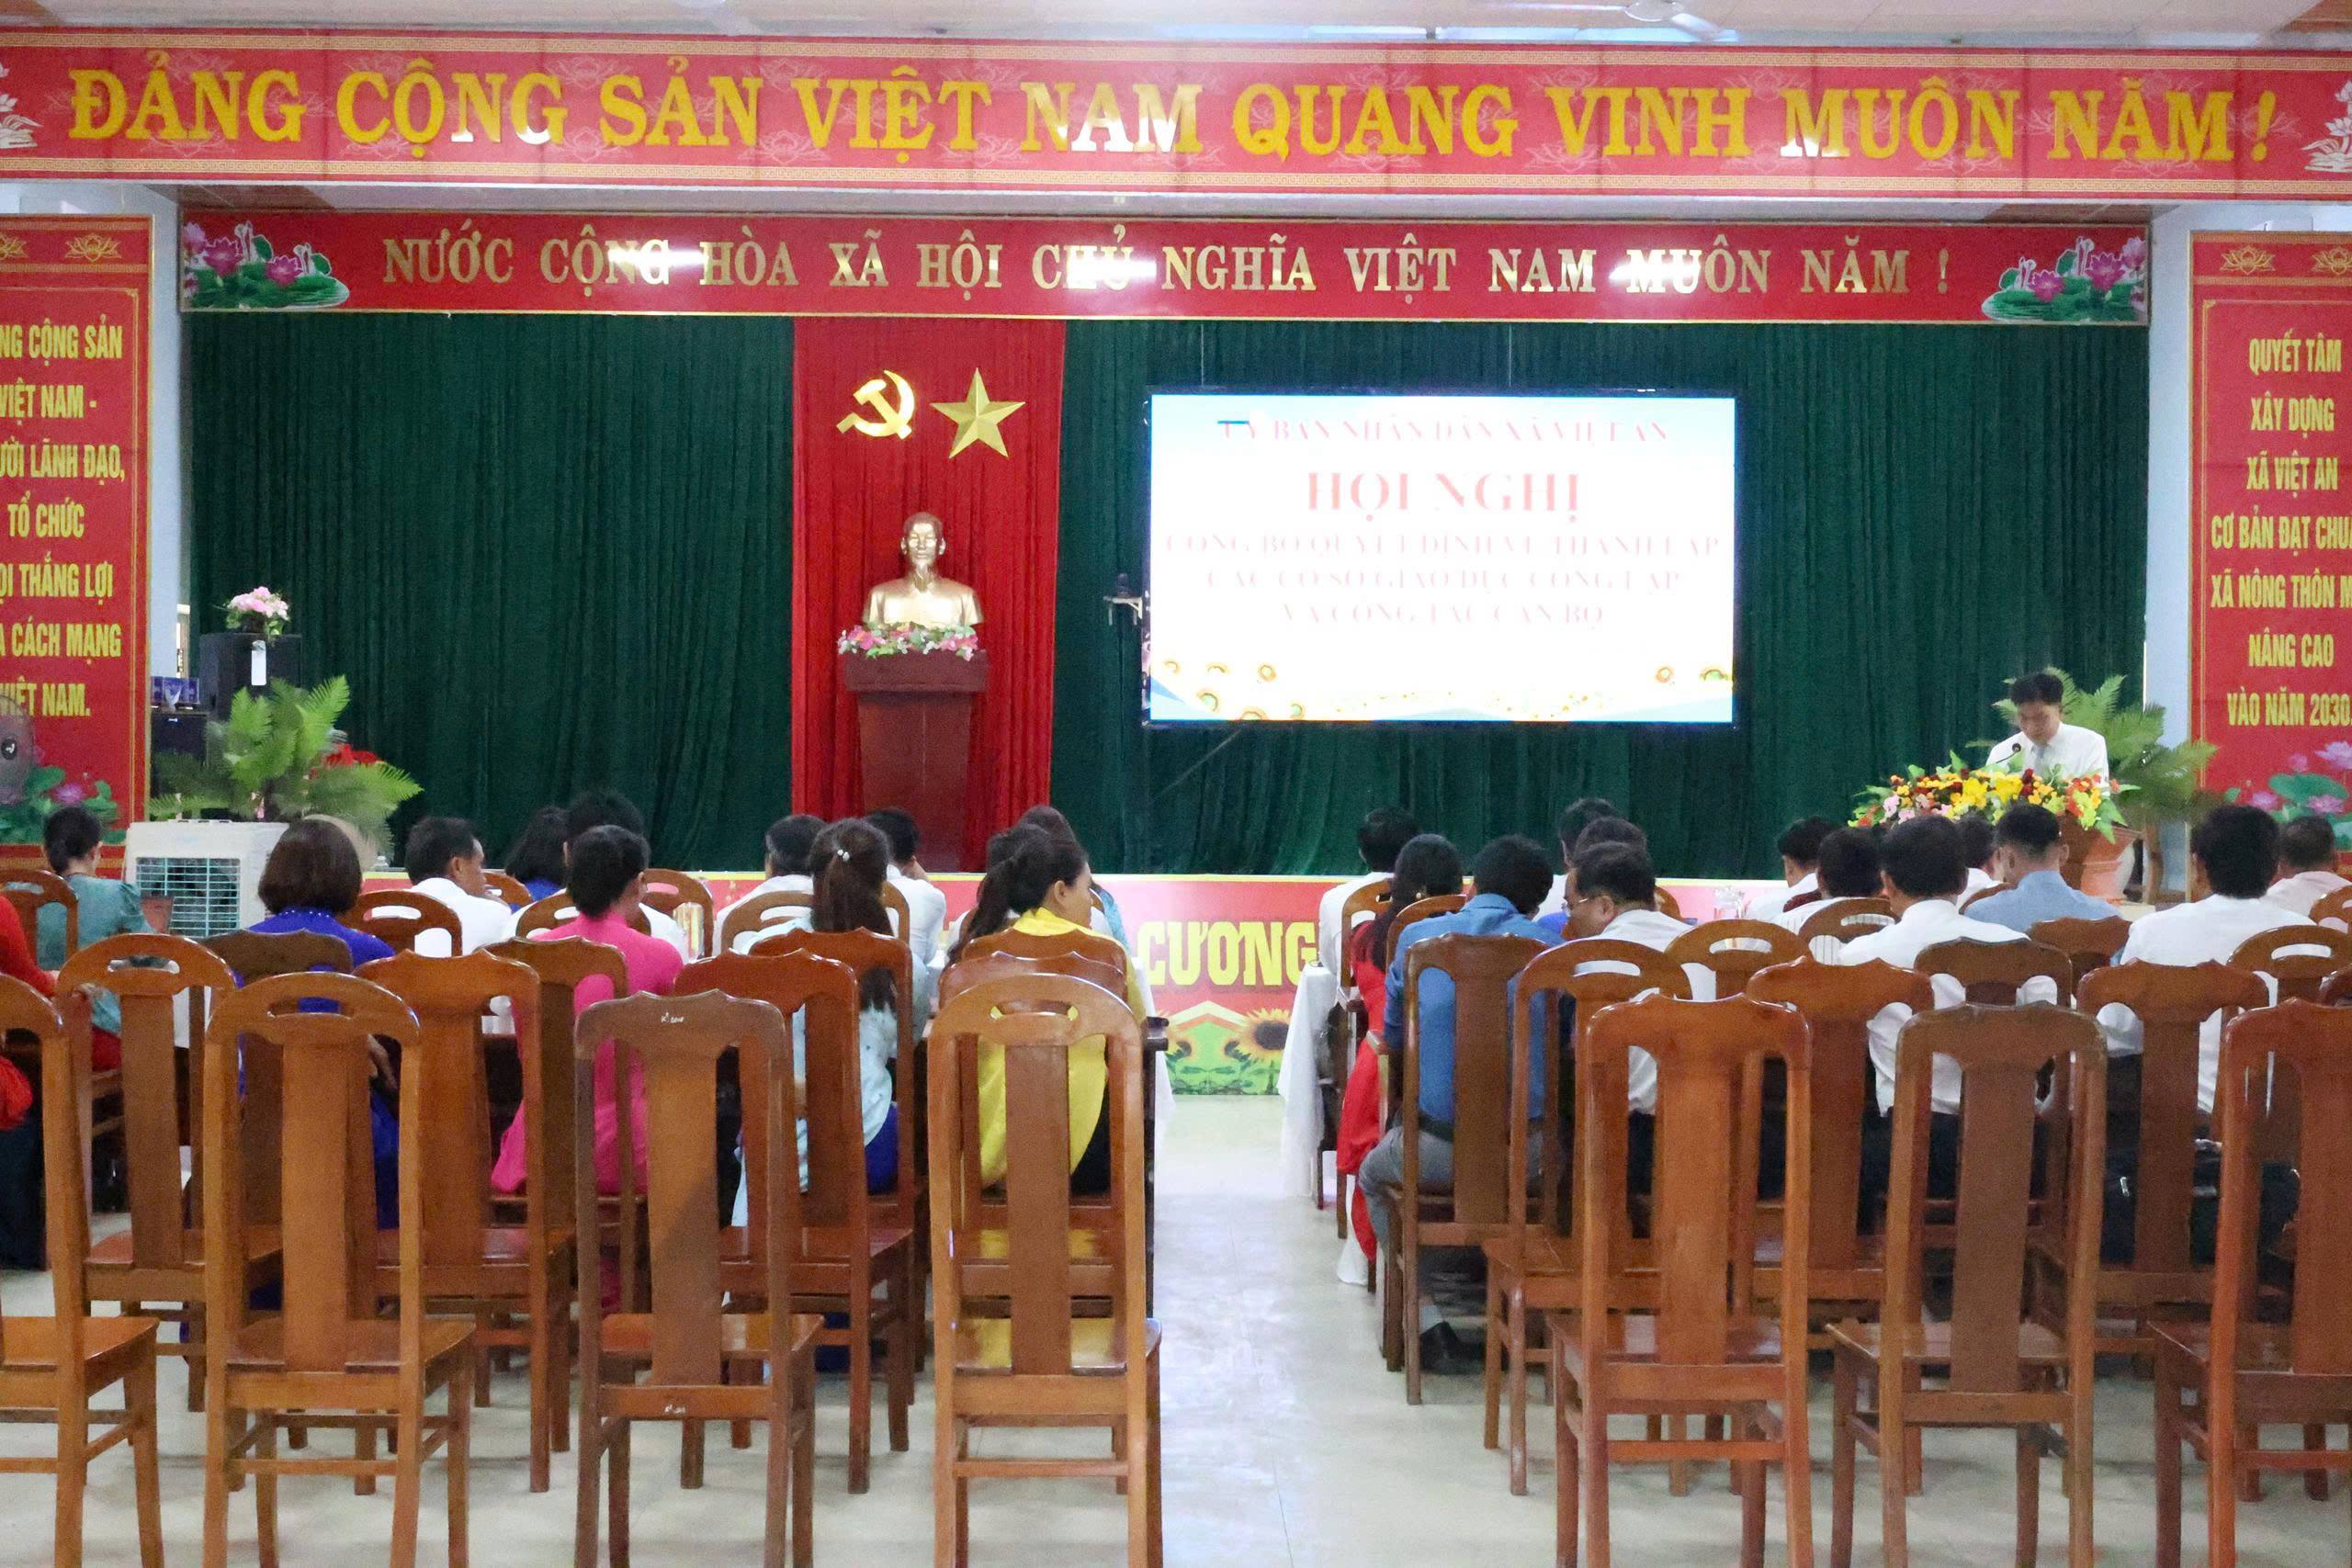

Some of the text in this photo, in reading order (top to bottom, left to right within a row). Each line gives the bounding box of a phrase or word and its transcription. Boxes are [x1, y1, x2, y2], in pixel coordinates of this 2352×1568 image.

[68, 51, 307, 143] ĐẢNG
[336, 57, 568, 158] CỘNG
[599, 55, 764, 147] SẢN
[790, 64, 991, 164] VIỆT
[1020, 81, 1204, 153] NAM
[1232, 83, 1519, 163] QUANG
[1545, 85, 1751, 158] VINH
[1781, 76, 2020, 159] MUÔN
[2049, 78, 2235, 162] NĂM
[382, 217, 514, 285] NƯỚC
[539, 223, 671, 297] CỘNG
[699, 225, 798, 287] HÒA
[829, 229, 889, 288] XÃ
[916, 229, 1003, 300] HỘI
[1032, 223, 1134, 291] CHỦ
[1162, 232, 1317, 292] NGHĨA
[1344, 233, 1457, 304] VIỆT
[1488, 247, 1596, 293] NAM
[1626, 235, 1771, 295] MUÔN
[1801, 235, 1910, 295] NĂM
[28, 317, 78, 367] CỘNG
[85, 313, 123, 359] SẢN
[2249, 328, 2342, 376] QUYẾT TÂM
[0, 377, 36, 426] VIỆT
[40, 385, 84, 418] NAM
[2251, 390, 2335, 439] XÂY DỰNG
[30, 437, 78, 479] LÃNH
[84, 444, 126, 486] ĐẠO,
[2246, 450, 2338, 499] XÃ VIỆT AN
[7, 490, 85, 538] TỔ CHỨC
[2211, 504, 2352, 557] CƠ BẢN ĐẠT CHU
[18, 551, 80, 598] THẮNG
[85, 560, 113, 605] LỢI
[2211, 567, 2234, 608] XÃ
[2239, 567, 2286, 608] NÔNG
[2290, 567, 2335, 608] THÔN
[11, 615, 61, 658] CÁCH
[66, 623, 121, 665] MẠNG
[2248, 626, 2335, 668] NÂNG CAO
[42, 682, 91, 716] NAM.
[2227, 685, 2260, 726] VÀO
[2265, 686, 2304, 726] NĂM
